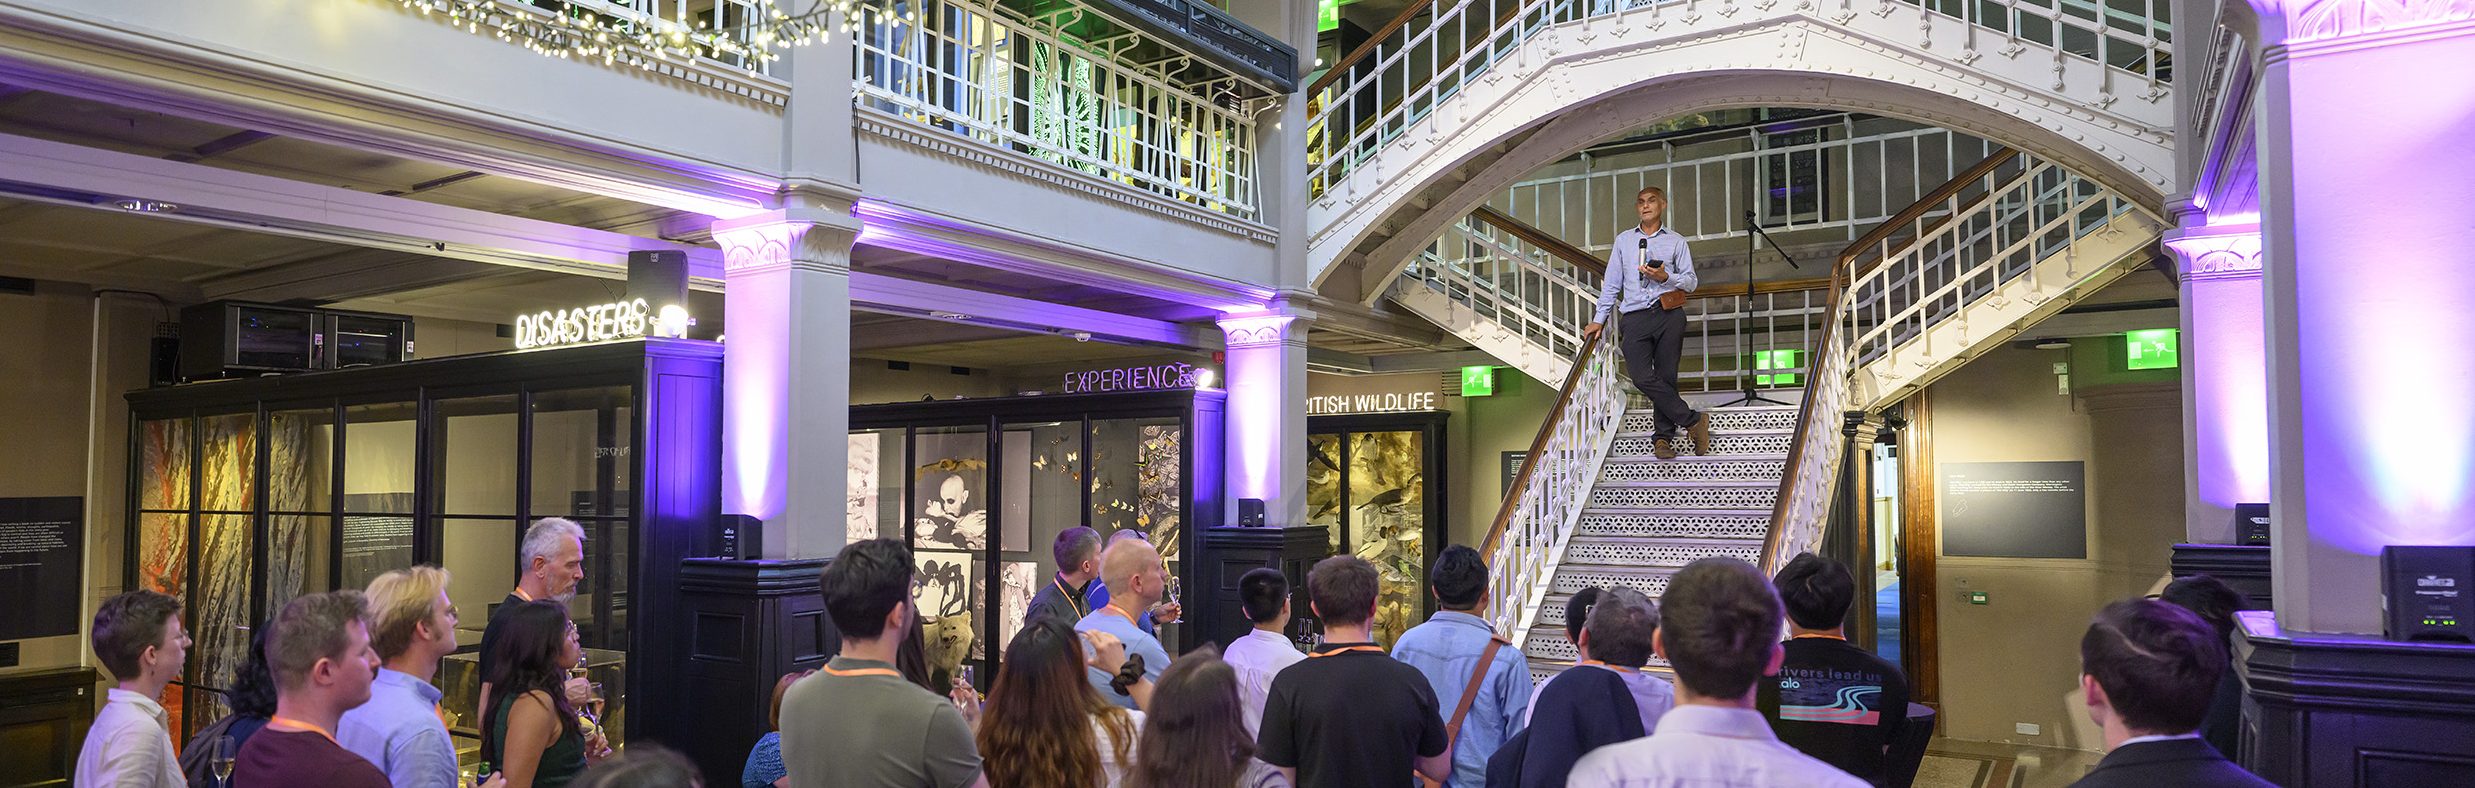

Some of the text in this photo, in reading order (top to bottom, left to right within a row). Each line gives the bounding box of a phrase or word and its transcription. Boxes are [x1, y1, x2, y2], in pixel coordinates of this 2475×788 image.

[515, 298, 649, 349] DISASTERS
[1064, 364, 1192, 393] EXPERIENCE
[1354, 391, 1435, 412] WILDLIFE
[1778, 666, 1824, 679] rivers
[1829, 668, 1861, 680] lead
[1780, 677, 1800, 689] alo
